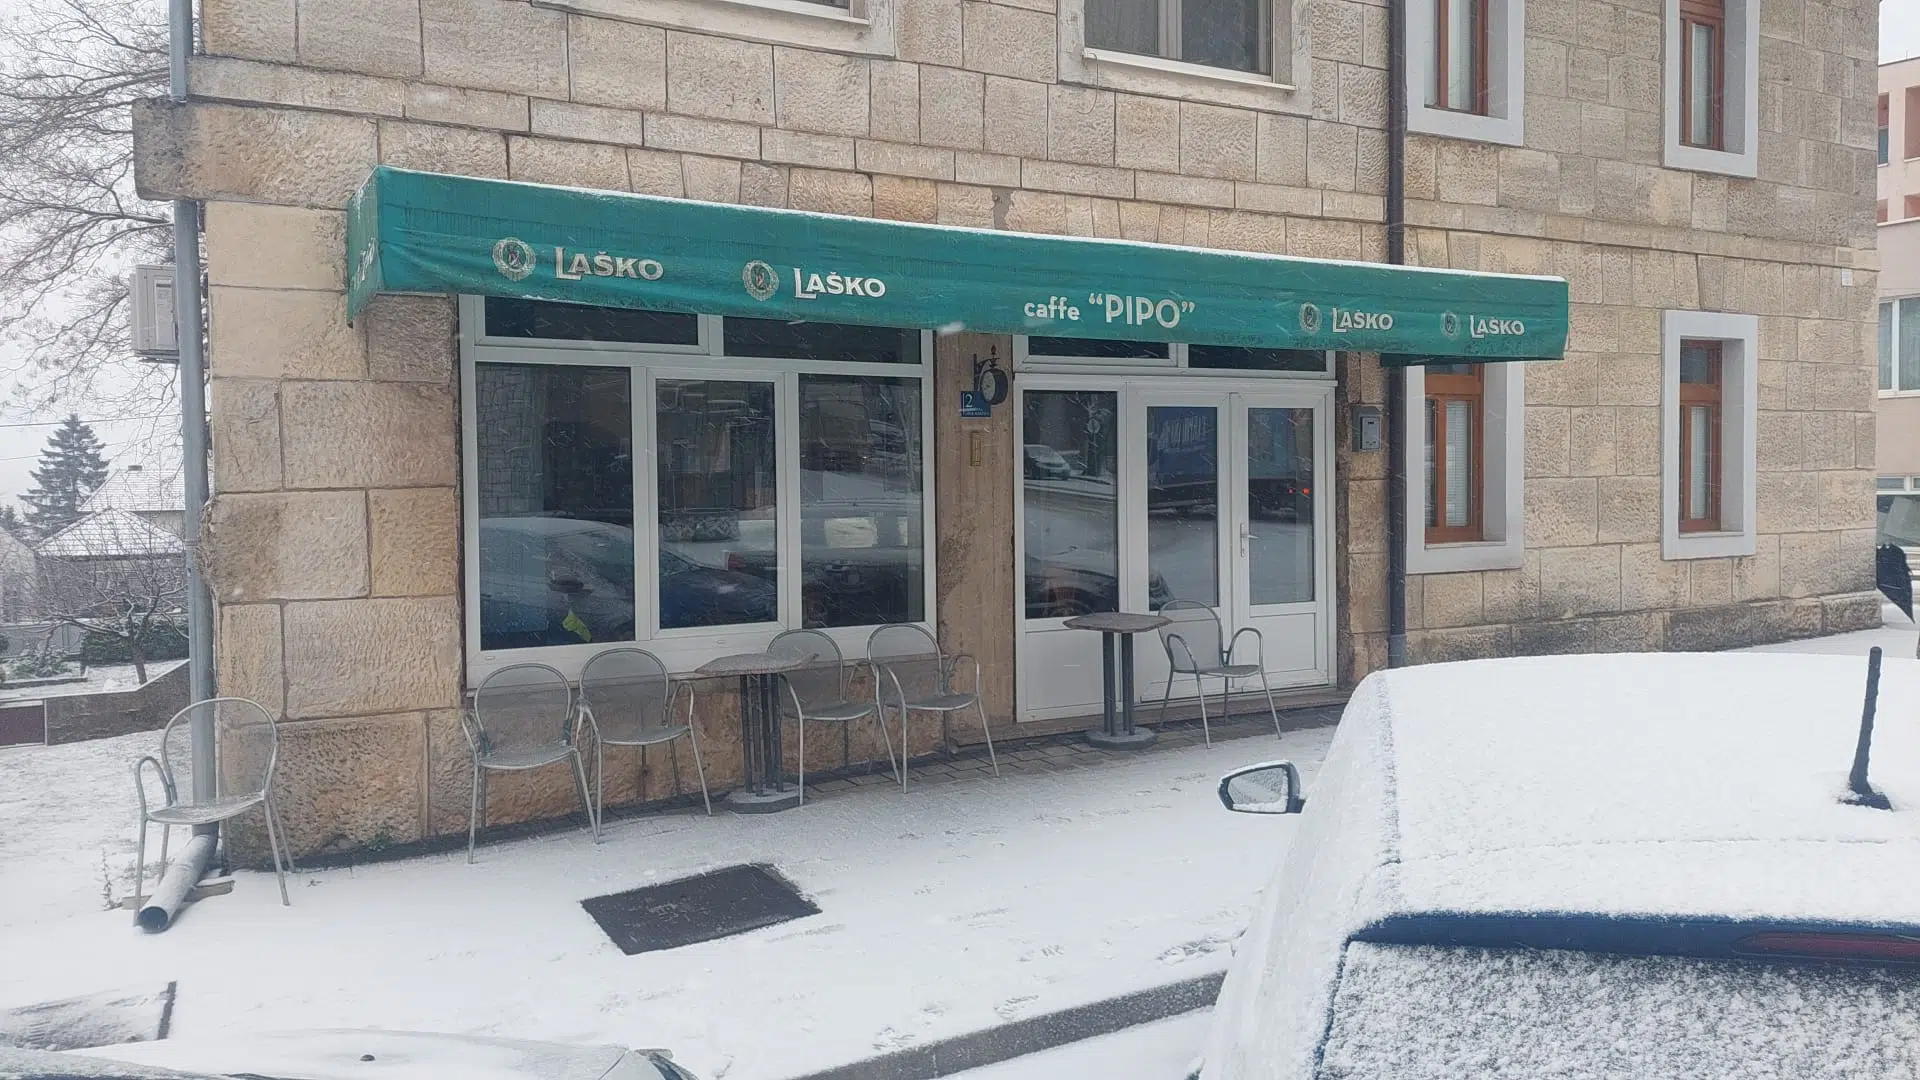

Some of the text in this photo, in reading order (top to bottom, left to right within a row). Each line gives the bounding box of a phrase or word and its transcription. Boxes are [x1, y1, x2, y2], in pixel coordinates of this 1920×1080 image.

[554, 246, 664, 280] LAŠKO
[794, 268, 886, 299] LAŠKO
[1024, 296, 1080, 320] caffe
[1332, 308, 1393, 333] LAŠKO
[1469, 314, 1525, 338] LAŠKO
[965, 394, 973, 408] 2
